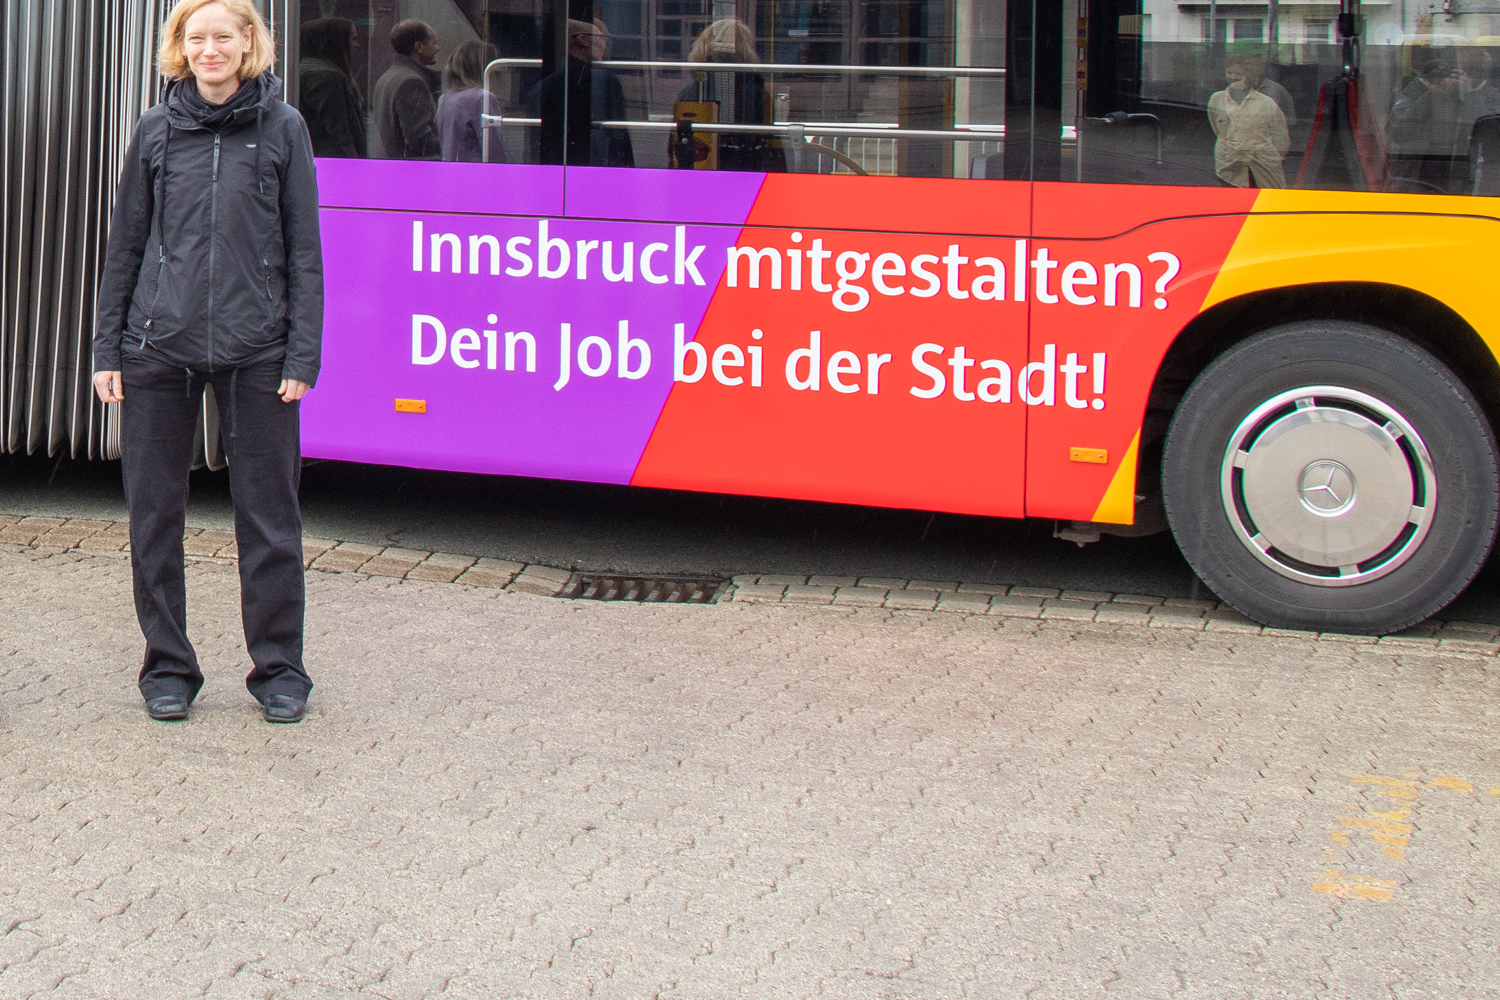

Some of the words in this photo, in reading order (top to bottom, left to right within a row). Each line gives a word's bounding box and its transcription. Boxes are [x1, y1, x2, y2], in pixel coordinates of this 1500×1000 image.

[411, 219, 707, 286] Innsbruck
[726, 231, 1181, 313] mitgestalten?
[411, 313, 537, 373] Dein
[552, 319, 652, 392] Job
[673, 322, 764, 388] bei
[785, 330, 892, 395] der
[909, 342, 1106, 411] Stadt!
